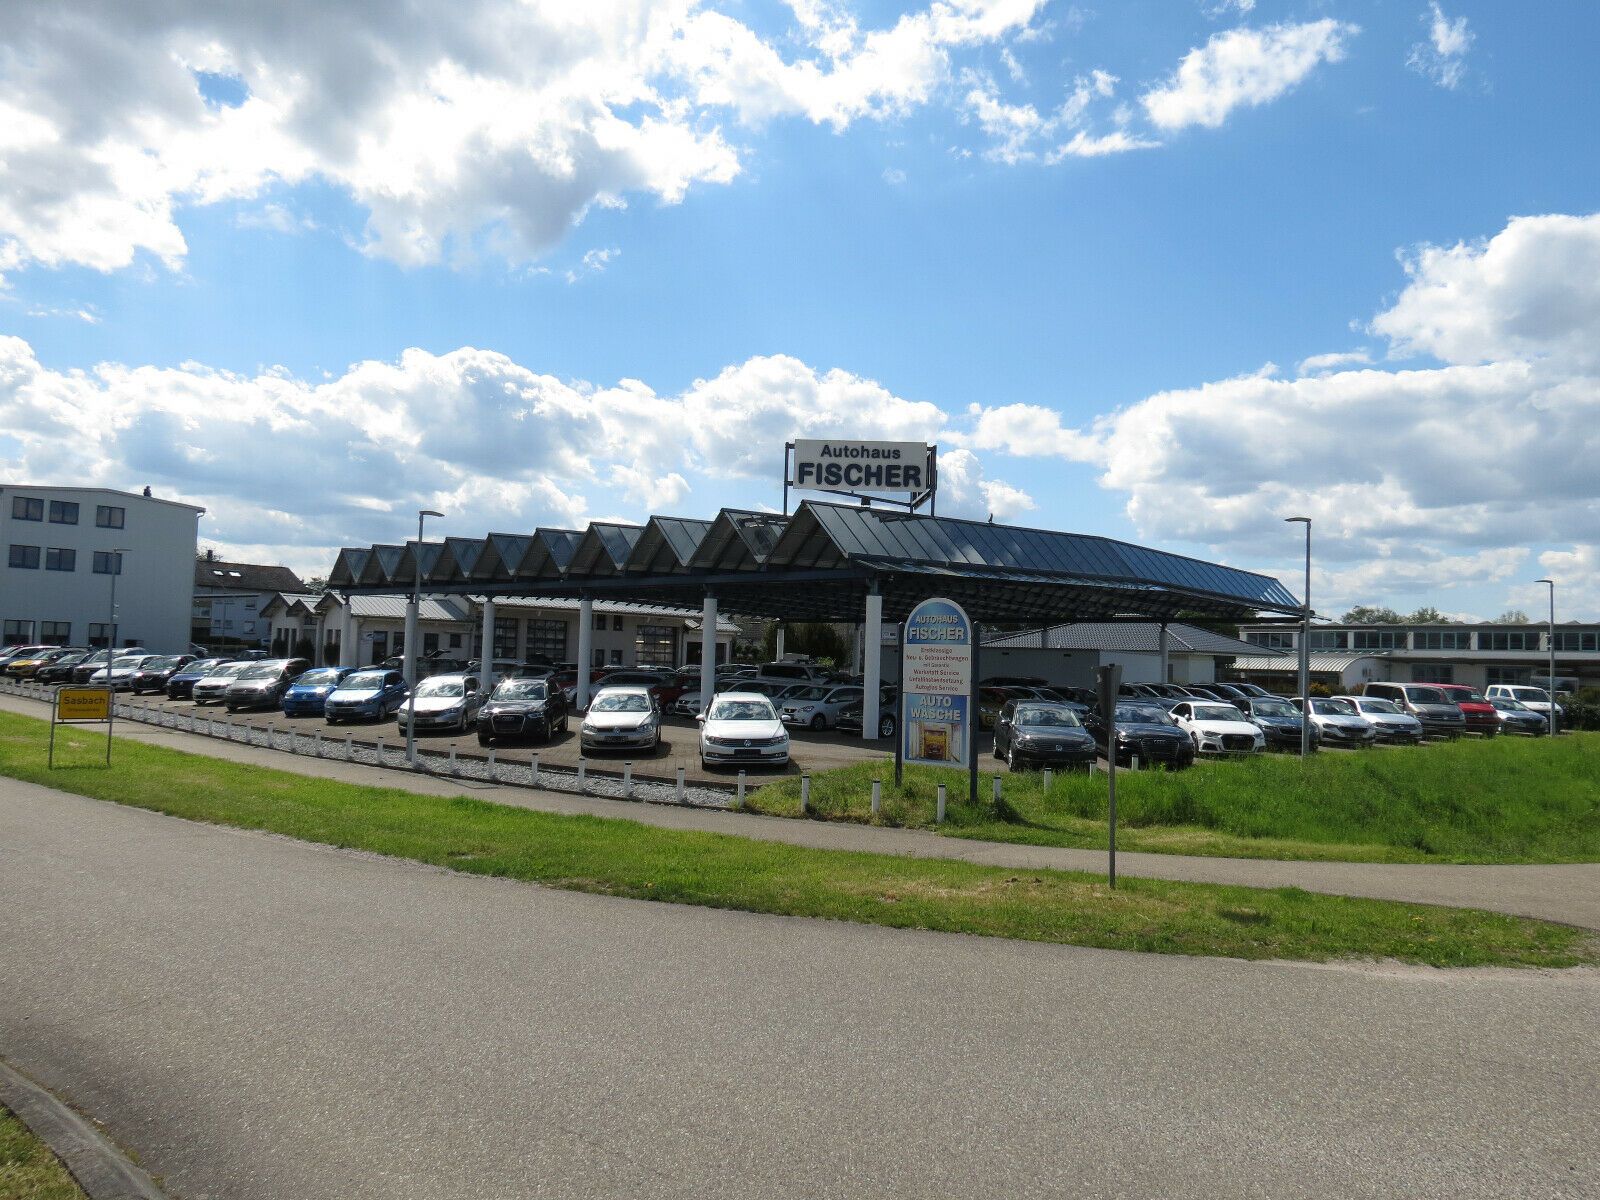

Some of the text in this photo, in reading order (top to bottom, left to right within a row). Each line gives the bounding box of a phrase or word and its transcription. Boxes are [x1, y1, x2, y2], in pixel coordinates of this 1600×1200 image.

[820, 444, 900, 459] Autohaus
[798, 463, 922, 487] FISCHER
[915, 615, 959, 625] AUTOHAUS
[909, 627, 965, 640] FISCHER
[63, 696, 106, 705] Sasbach
[919, 695, 952, 707] AUTO
